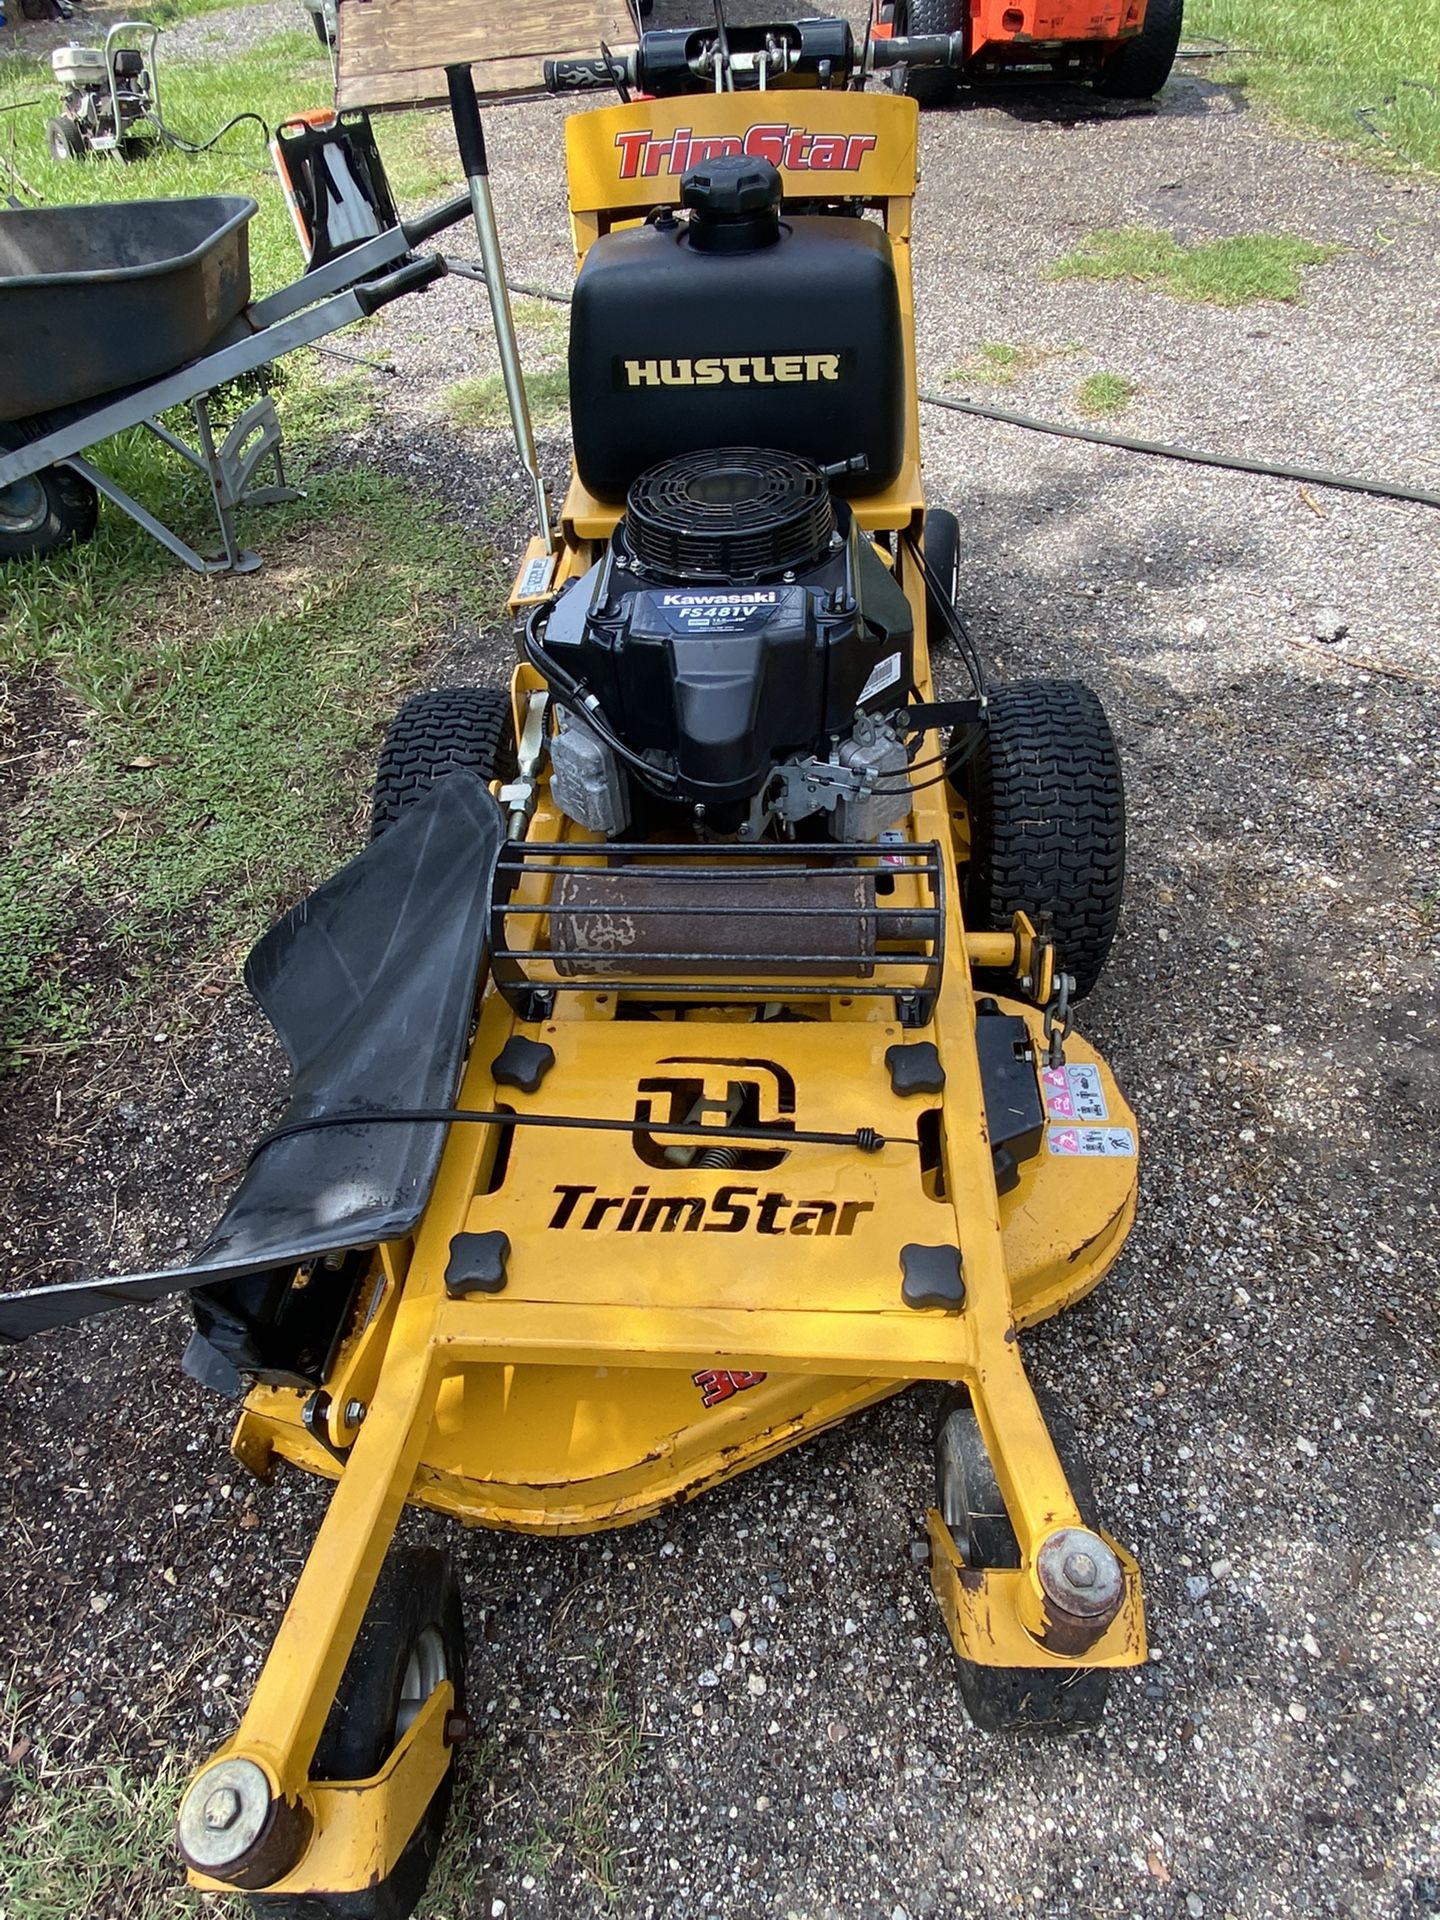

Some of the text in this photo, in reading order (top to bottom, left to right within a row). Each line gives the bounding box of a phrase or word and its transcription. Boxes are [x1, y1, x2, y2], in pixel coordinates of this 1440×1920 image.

[614, 123, 877, 179] TrimStar
[624, 354, 840, 386] HUSTLER
[663, 592, 776, 605] Kawasaki
[679, 606, 758, 618] FS481V
[547, 1184, 875, 1236] TrimStar
